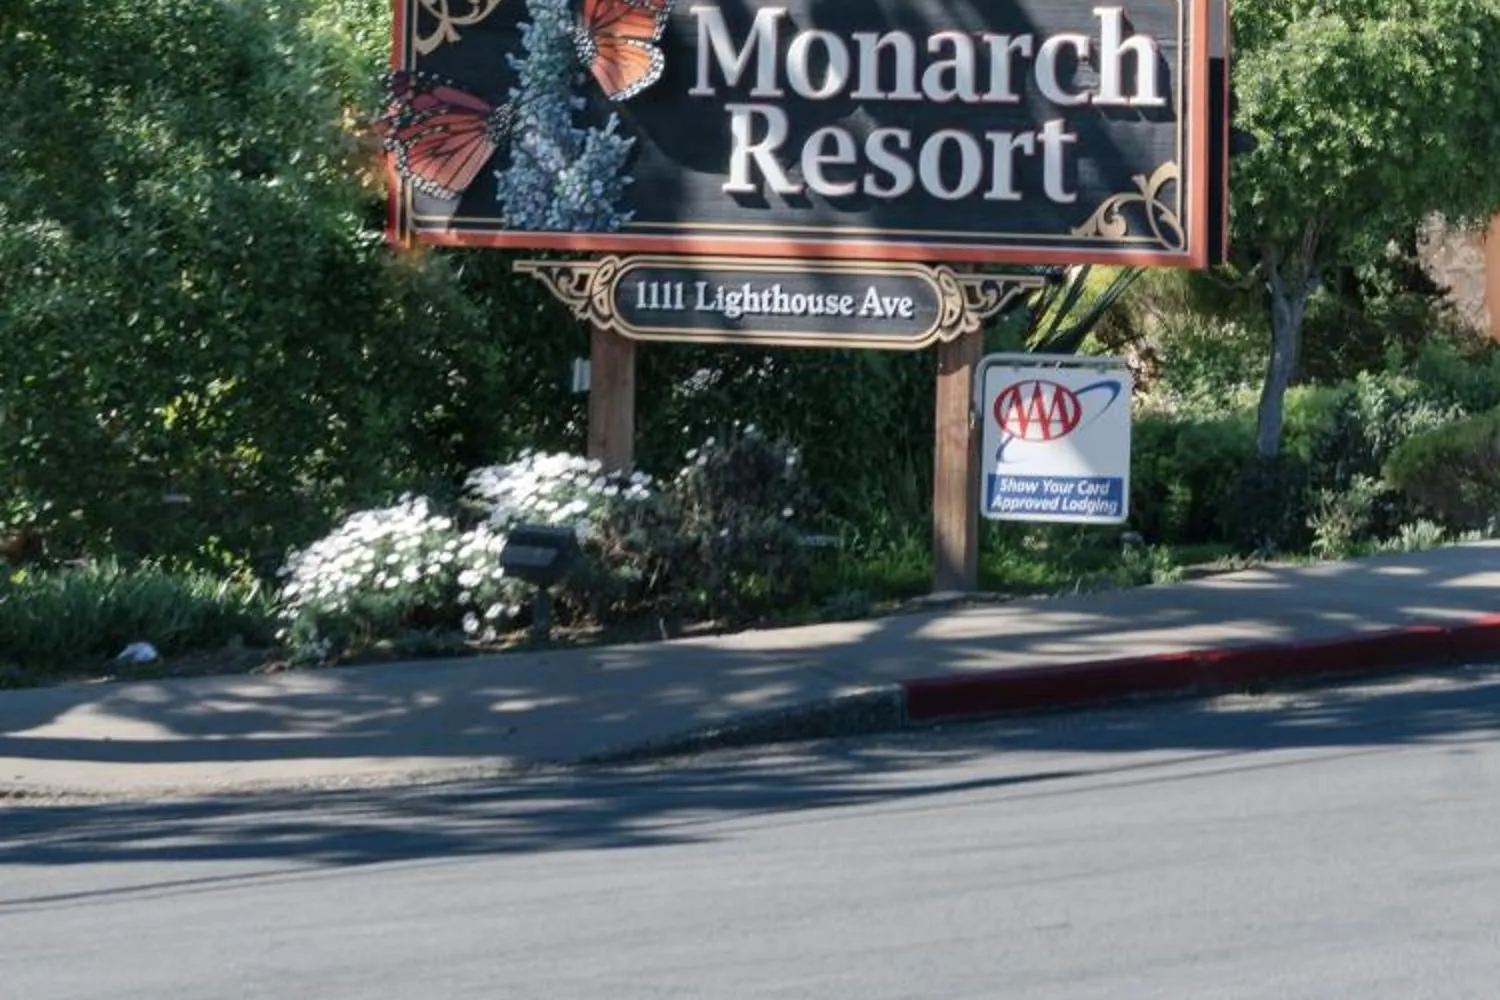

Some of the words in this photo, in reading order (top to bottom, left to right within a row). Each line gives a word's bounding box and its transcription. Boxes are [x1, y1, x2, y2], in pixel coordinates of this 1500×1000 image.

[688, 4, 1166, 108] Monarch
[721, 103, 1078, 202] Resort
[635, 280, 685, 311] 1111
[695, 281, 853, 319] Lighthouse
[858, 286, 914, 319] Ave
[1000, 379, 1074, 441] AAA
[991, 496, 1060, 512] Approved
[1061, 496, 1118, 515] Lodging
[1000, 478, 1040, 494] Show
[1042, 479, 1075, 494] Your
[1077, 479, 1111, 495] Card
